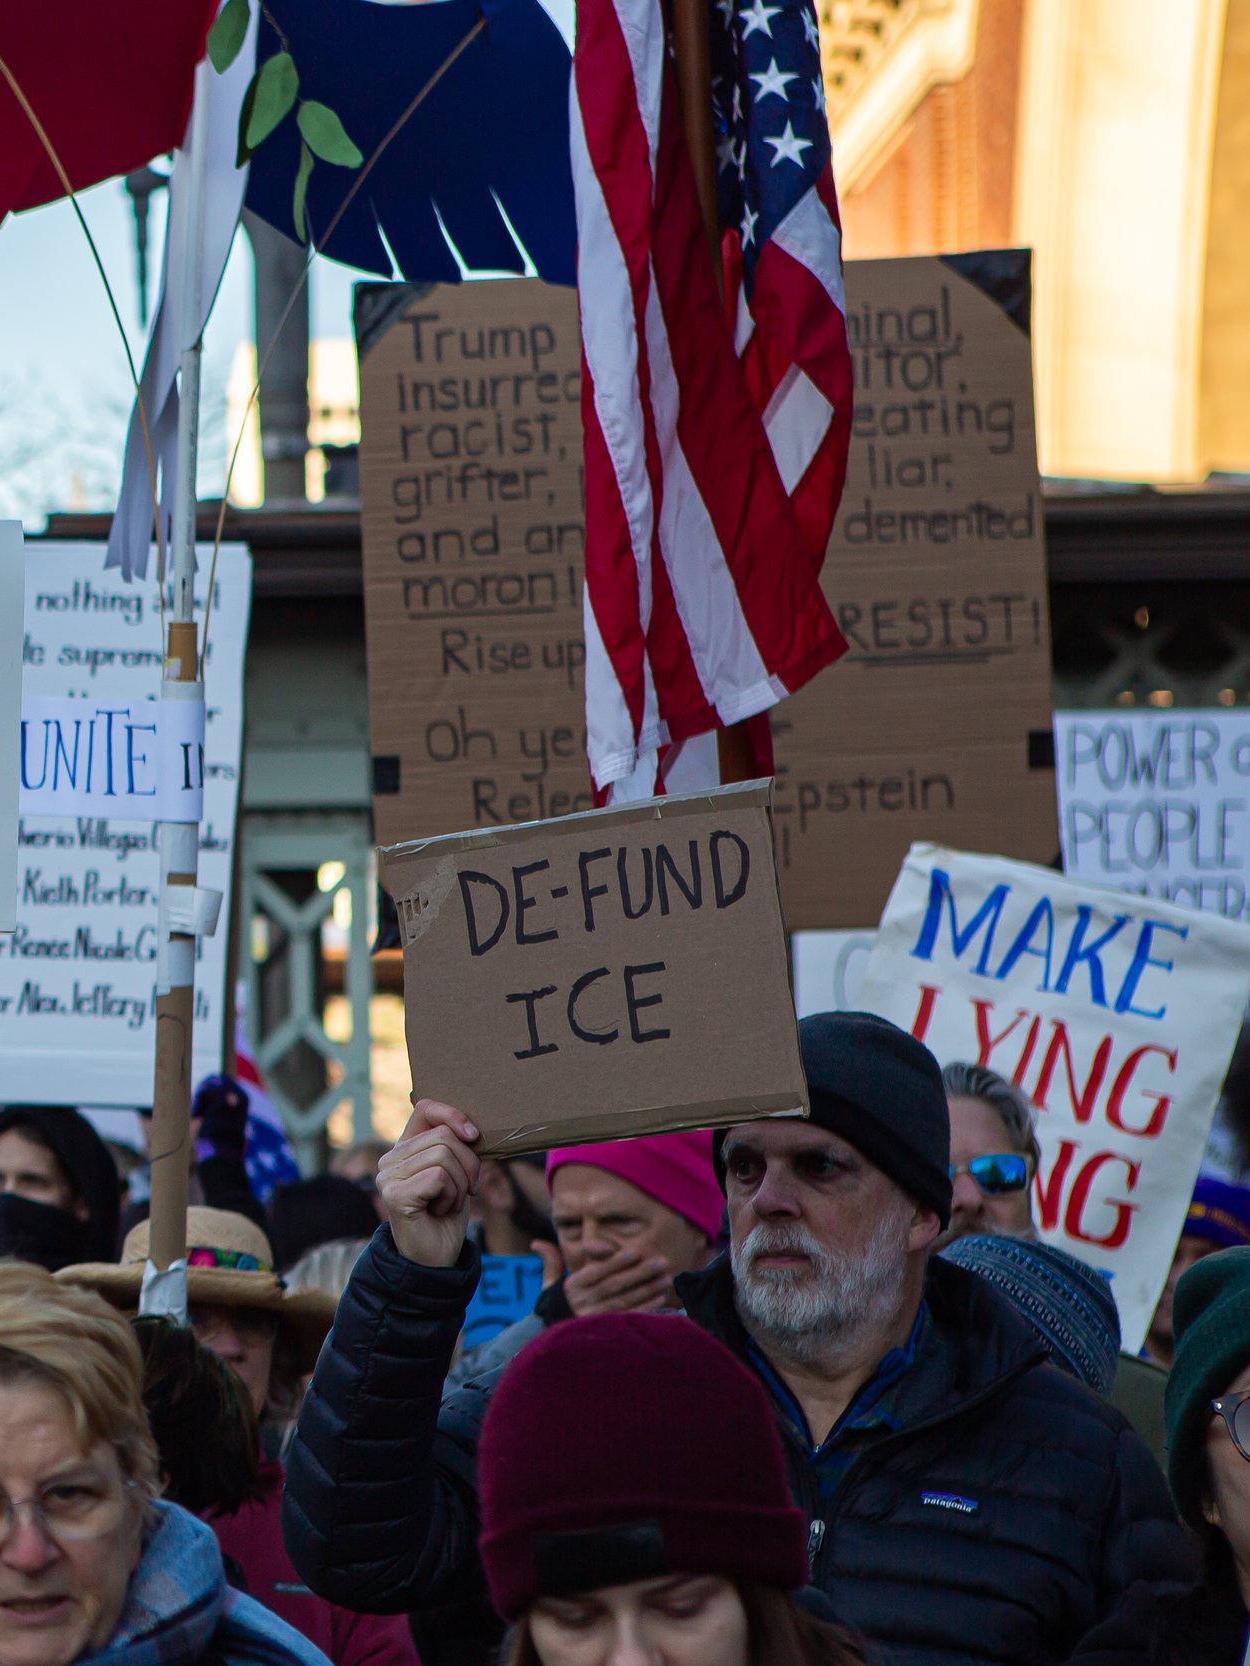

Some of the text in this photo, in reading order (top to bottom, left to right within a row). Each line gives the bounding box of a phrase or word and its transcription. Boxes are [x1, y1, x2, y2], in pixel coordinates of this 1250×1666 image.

[401, 285, 964, 372] Trump inal,
[397, 371, 581, 413] insurrec
[401, 396, 1015, 463] racist, eating
[393, 462, 555, 525] grifter,
[867, 443, 954, 492] liar,
[397, 512, 500, 563] and
[843, 491, 1035, 544] demented
[36, 578, 143, 627] nothing
[837, 590, 1041, 650] RESIST!
[441, 628, 533, 676] Rise
[19, 708, 156, 796] UNITE
[425, 703, 588, 782] Oh ye
[1066, 718, 1221, 792] POWER
[1066, 797, 1248, 874] PEOPLE
[456, 830, 750, 956] DE-FUND
[910, 867, 1189, 1020] MAKE
[505, 961, 671, 1060] ICE
[1034, 1139, 1141, 1250] NG
[923, 1496, 973, 1513] patagonia
